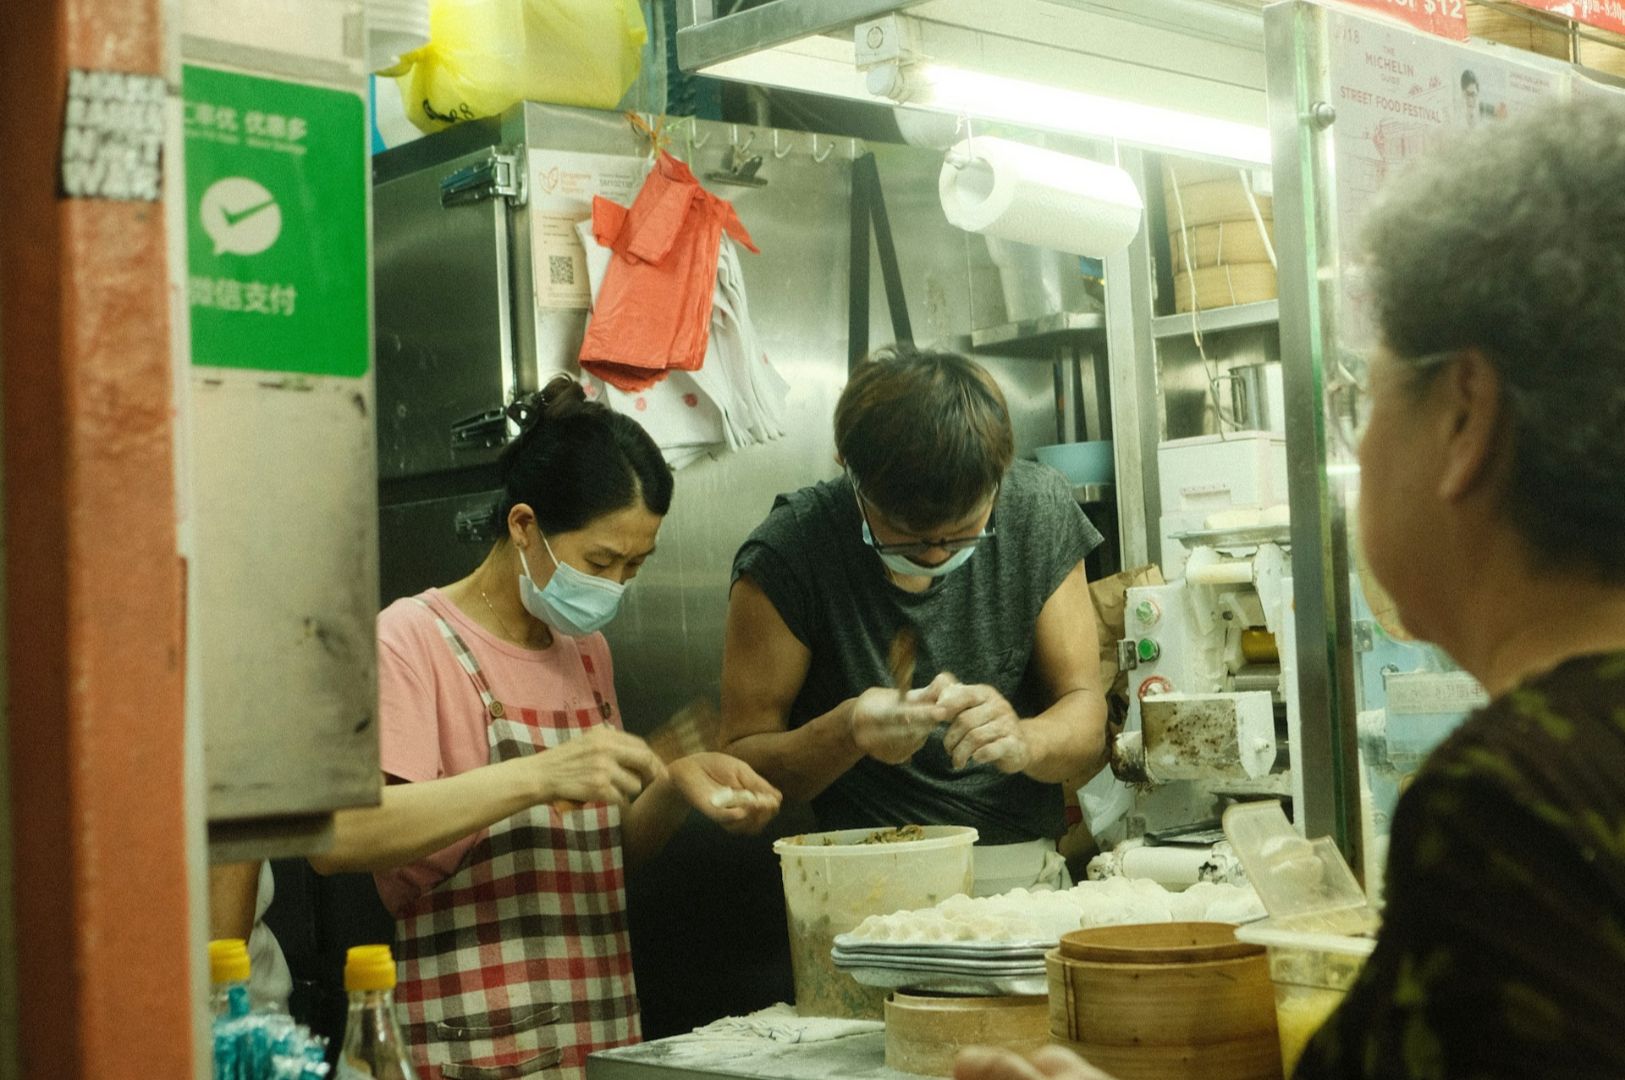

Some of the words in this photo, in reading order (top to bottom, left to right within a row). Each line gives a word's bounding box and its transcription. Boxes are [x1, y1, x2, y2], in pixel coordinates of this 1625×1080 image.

[1424, 0, 1463, 18] $12
[1364, 52, 1415, 77] MICHELIN
[1340, 85, 1373, 105] STREET
[1375, 95, 1401, 113] FOOD
[1402, 102, 1441, 123] FESTIVAL
